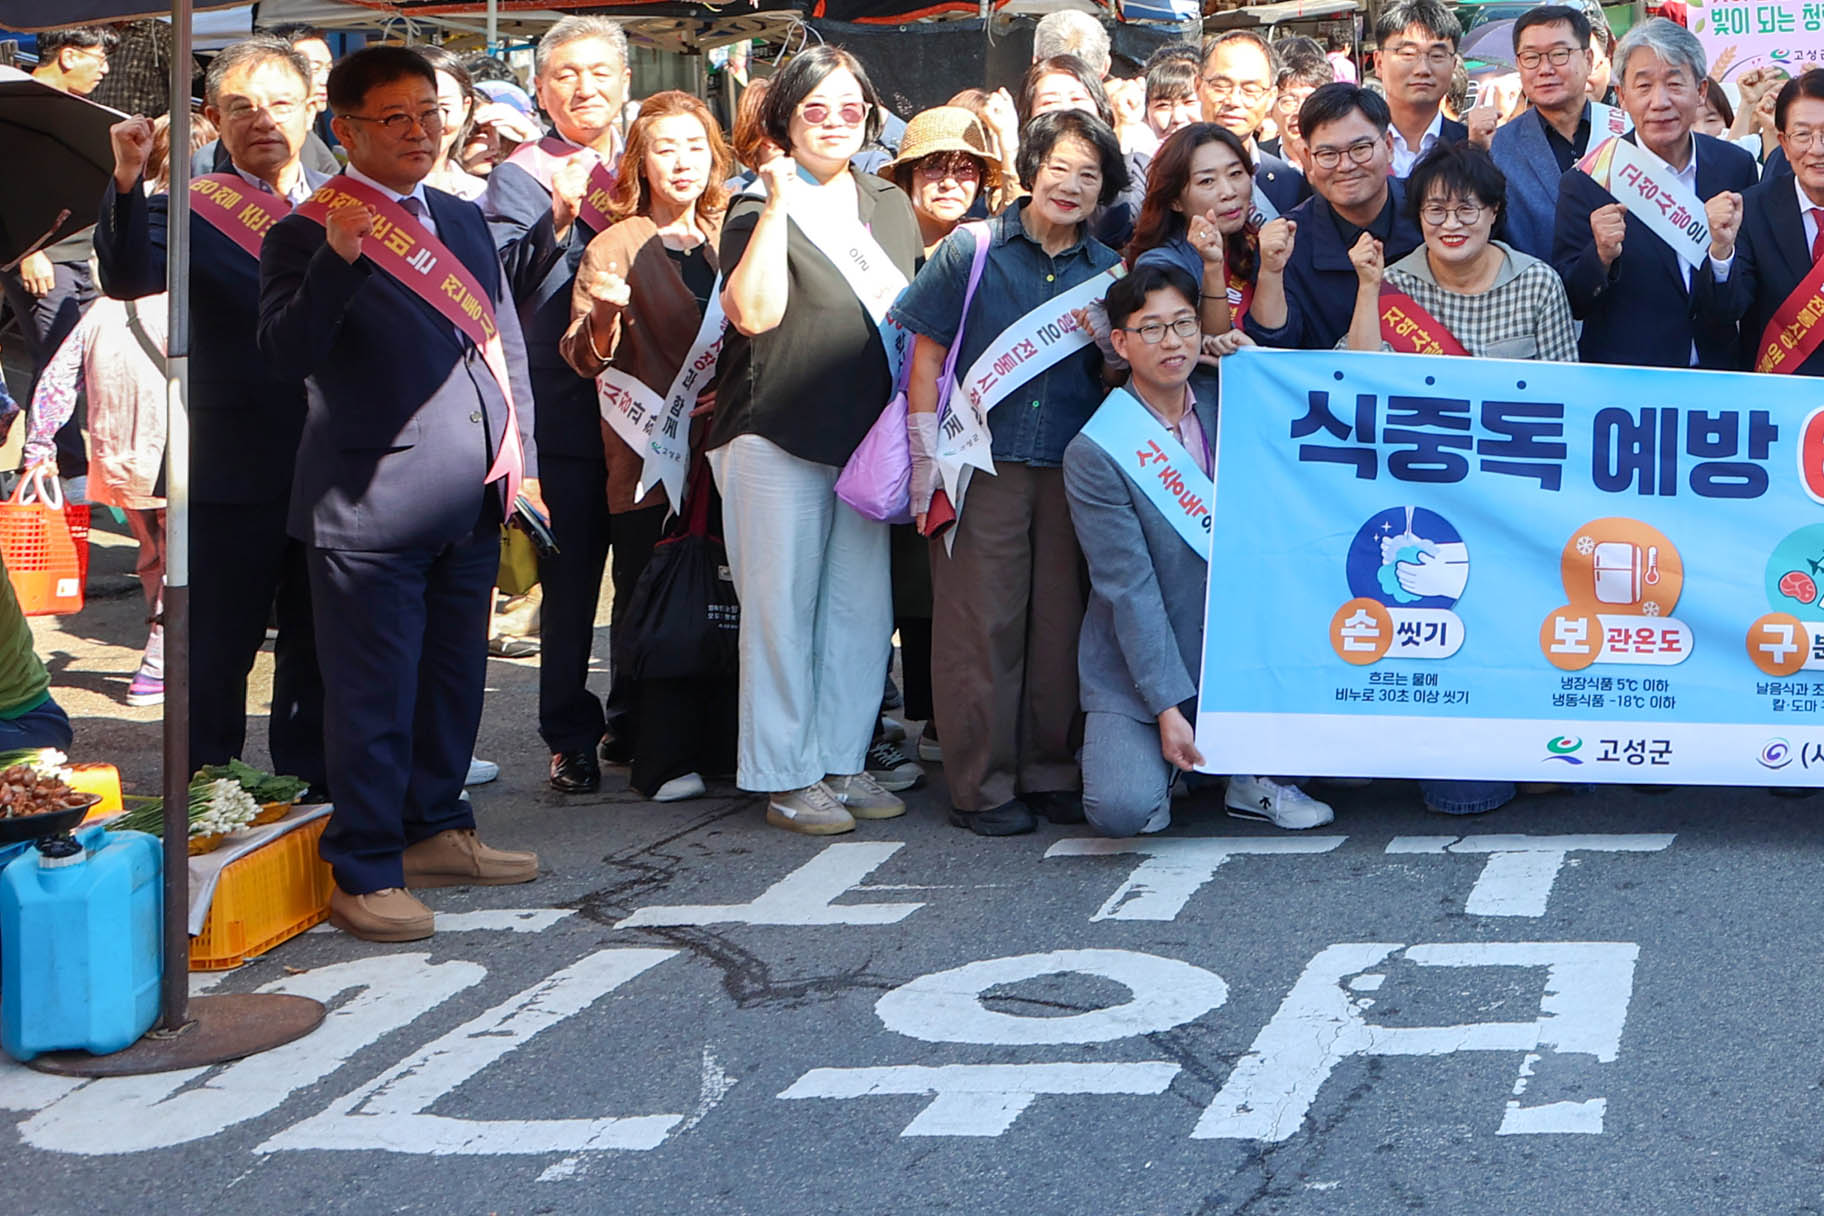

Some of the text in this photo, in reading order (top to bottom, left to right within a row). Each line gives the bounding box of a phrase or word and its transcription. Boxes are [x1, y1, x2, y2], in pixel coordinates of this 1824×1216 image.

[1711, 6, 1750, 36] 빛이
[1757, 5, 1795, 34] 되는
[1289, 390, 1568, 492] 식중독
[1591, 405, 1779, 500] 예방
[1368, 672, 1438, 686] 흐르는 물에
[1560, 677, 1669, 692] 냉장식품 이하
[1335, 688, 1469, 705] 비누로 30초 이상 씻기
[1756, 682, 1808, 696] 날음식과
[1552, 693, 1676, 710] 냉동식품 이하
[1596, 739, 1673, 766] 고성군
